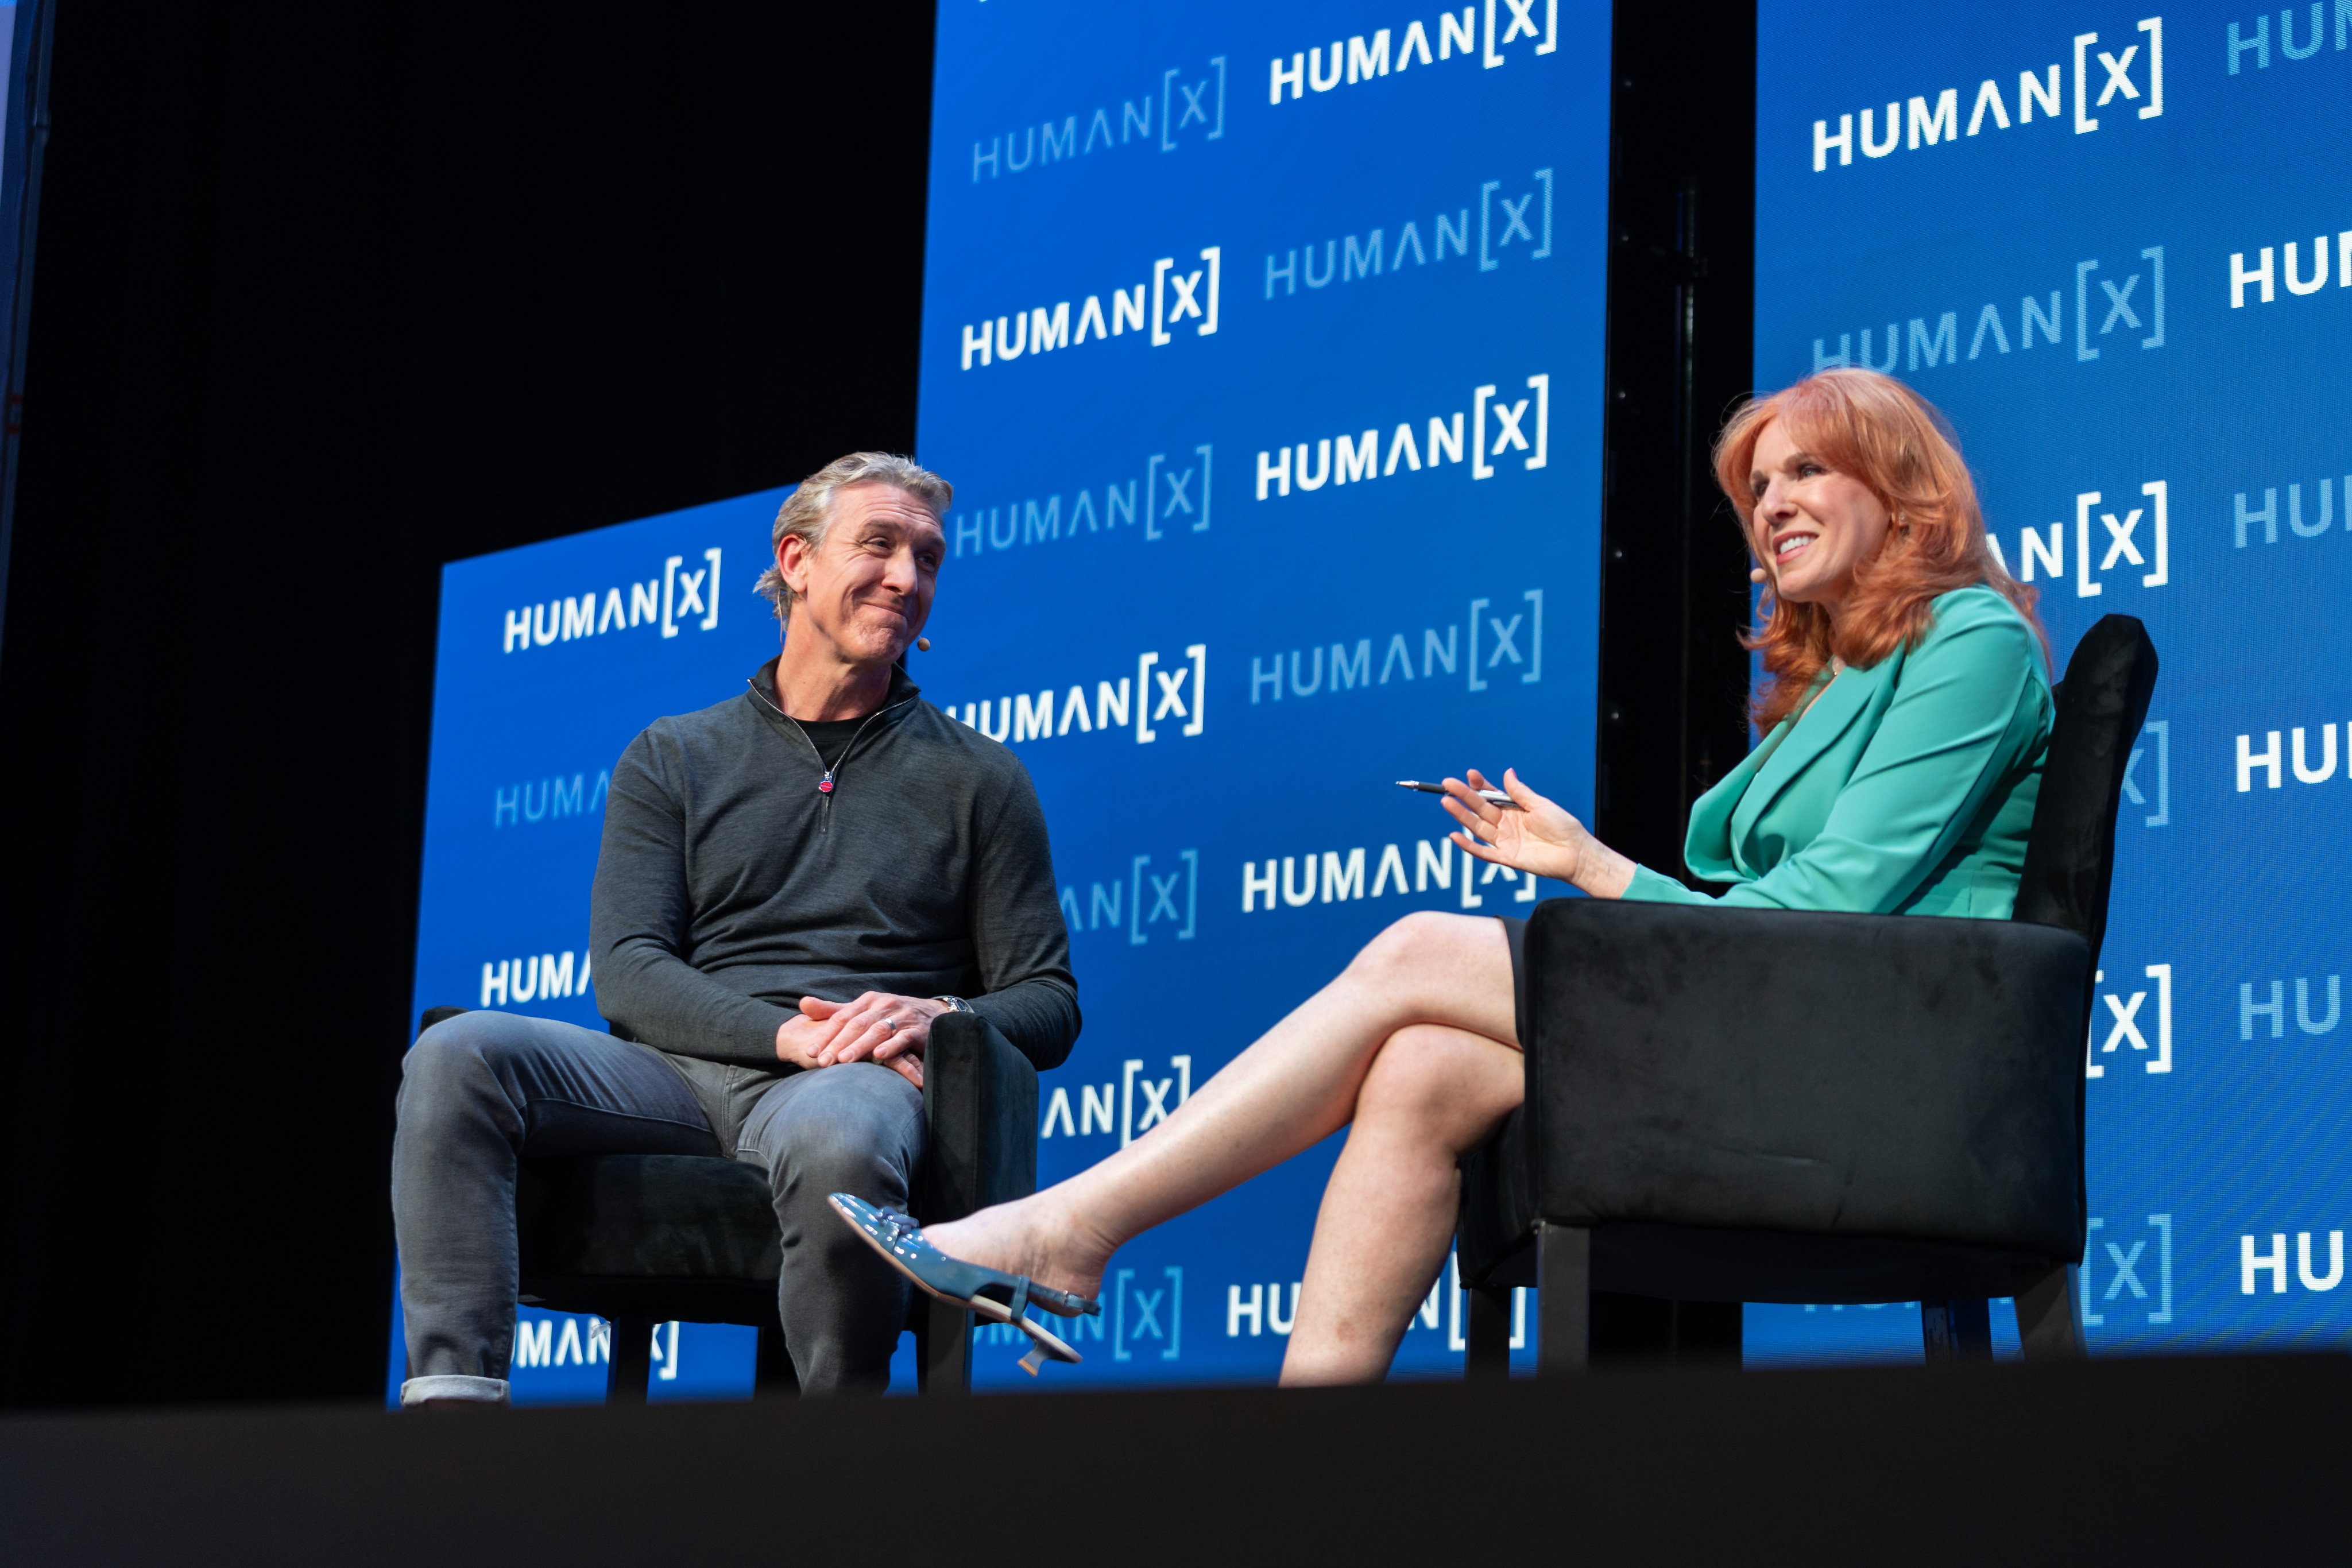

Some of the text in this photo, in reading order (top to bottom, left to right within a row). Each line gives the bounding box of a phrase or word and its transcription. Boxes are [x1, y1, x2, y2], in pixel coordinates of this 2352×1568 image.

[1269, 0, 1558, 106] HUMAN[X]
[1813, 16, 2164, 172] HUMAN[X]
[972, 55, 1227, 184] HUMAN[X]
[1264, 167, 1553, 300] HUMAN[X]
[2230, 230, 2352, 309] HU
[961, 246, 1221, 371] HUMAN[X]
[1812, 245, 2165, 377] HUMAN[X]
[1256, 373, 1549, 501] HUMAN[X]
[954, 443, 1213, 559] HUMAN[X]
[2234, 474, 2352, 549] HU
[504, 547, 722, 653] HUMAN[X]
[1251, 588, 1544, 704] HUMAN[X]
[2236, 721, 2352, 793] HU
